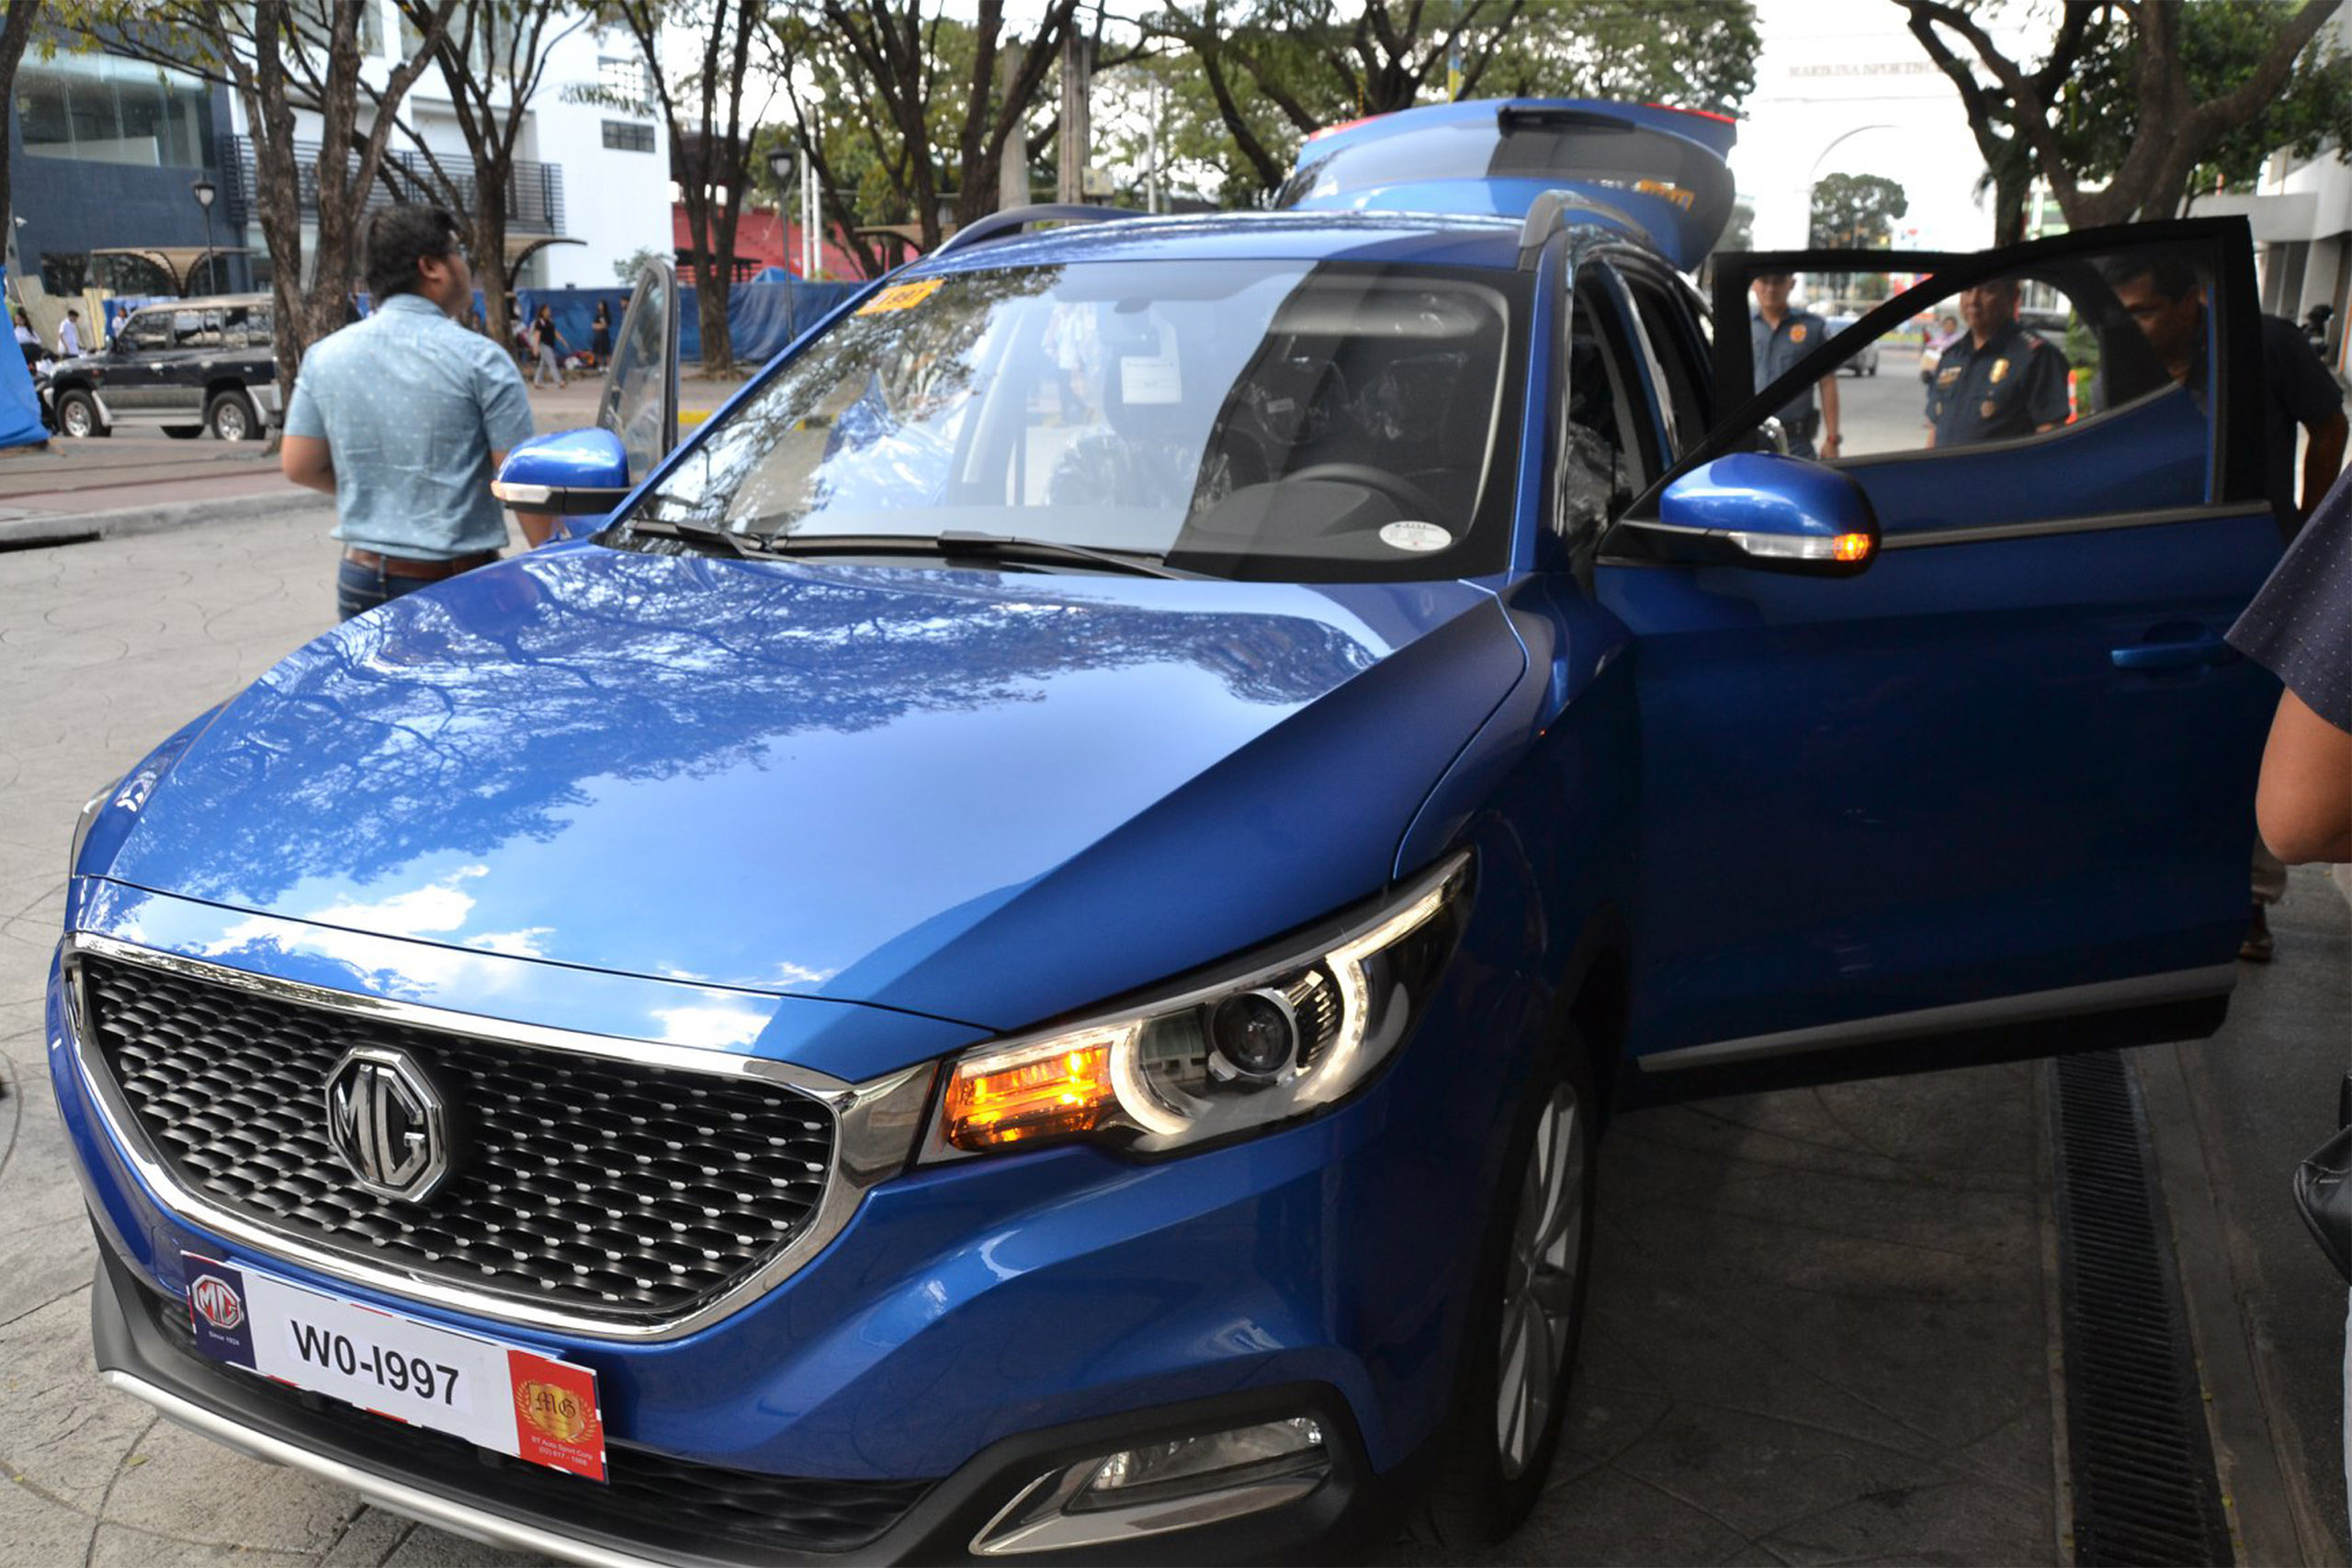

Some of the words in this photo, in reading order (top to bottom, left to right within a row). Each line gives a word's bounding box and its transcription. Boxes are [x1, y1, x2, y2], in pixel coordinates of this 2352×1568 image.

[334, 1064, 427, 1186] MG
[198, 1282, 238, 1325] MG
[536, 1392, 576, 1417] MG
